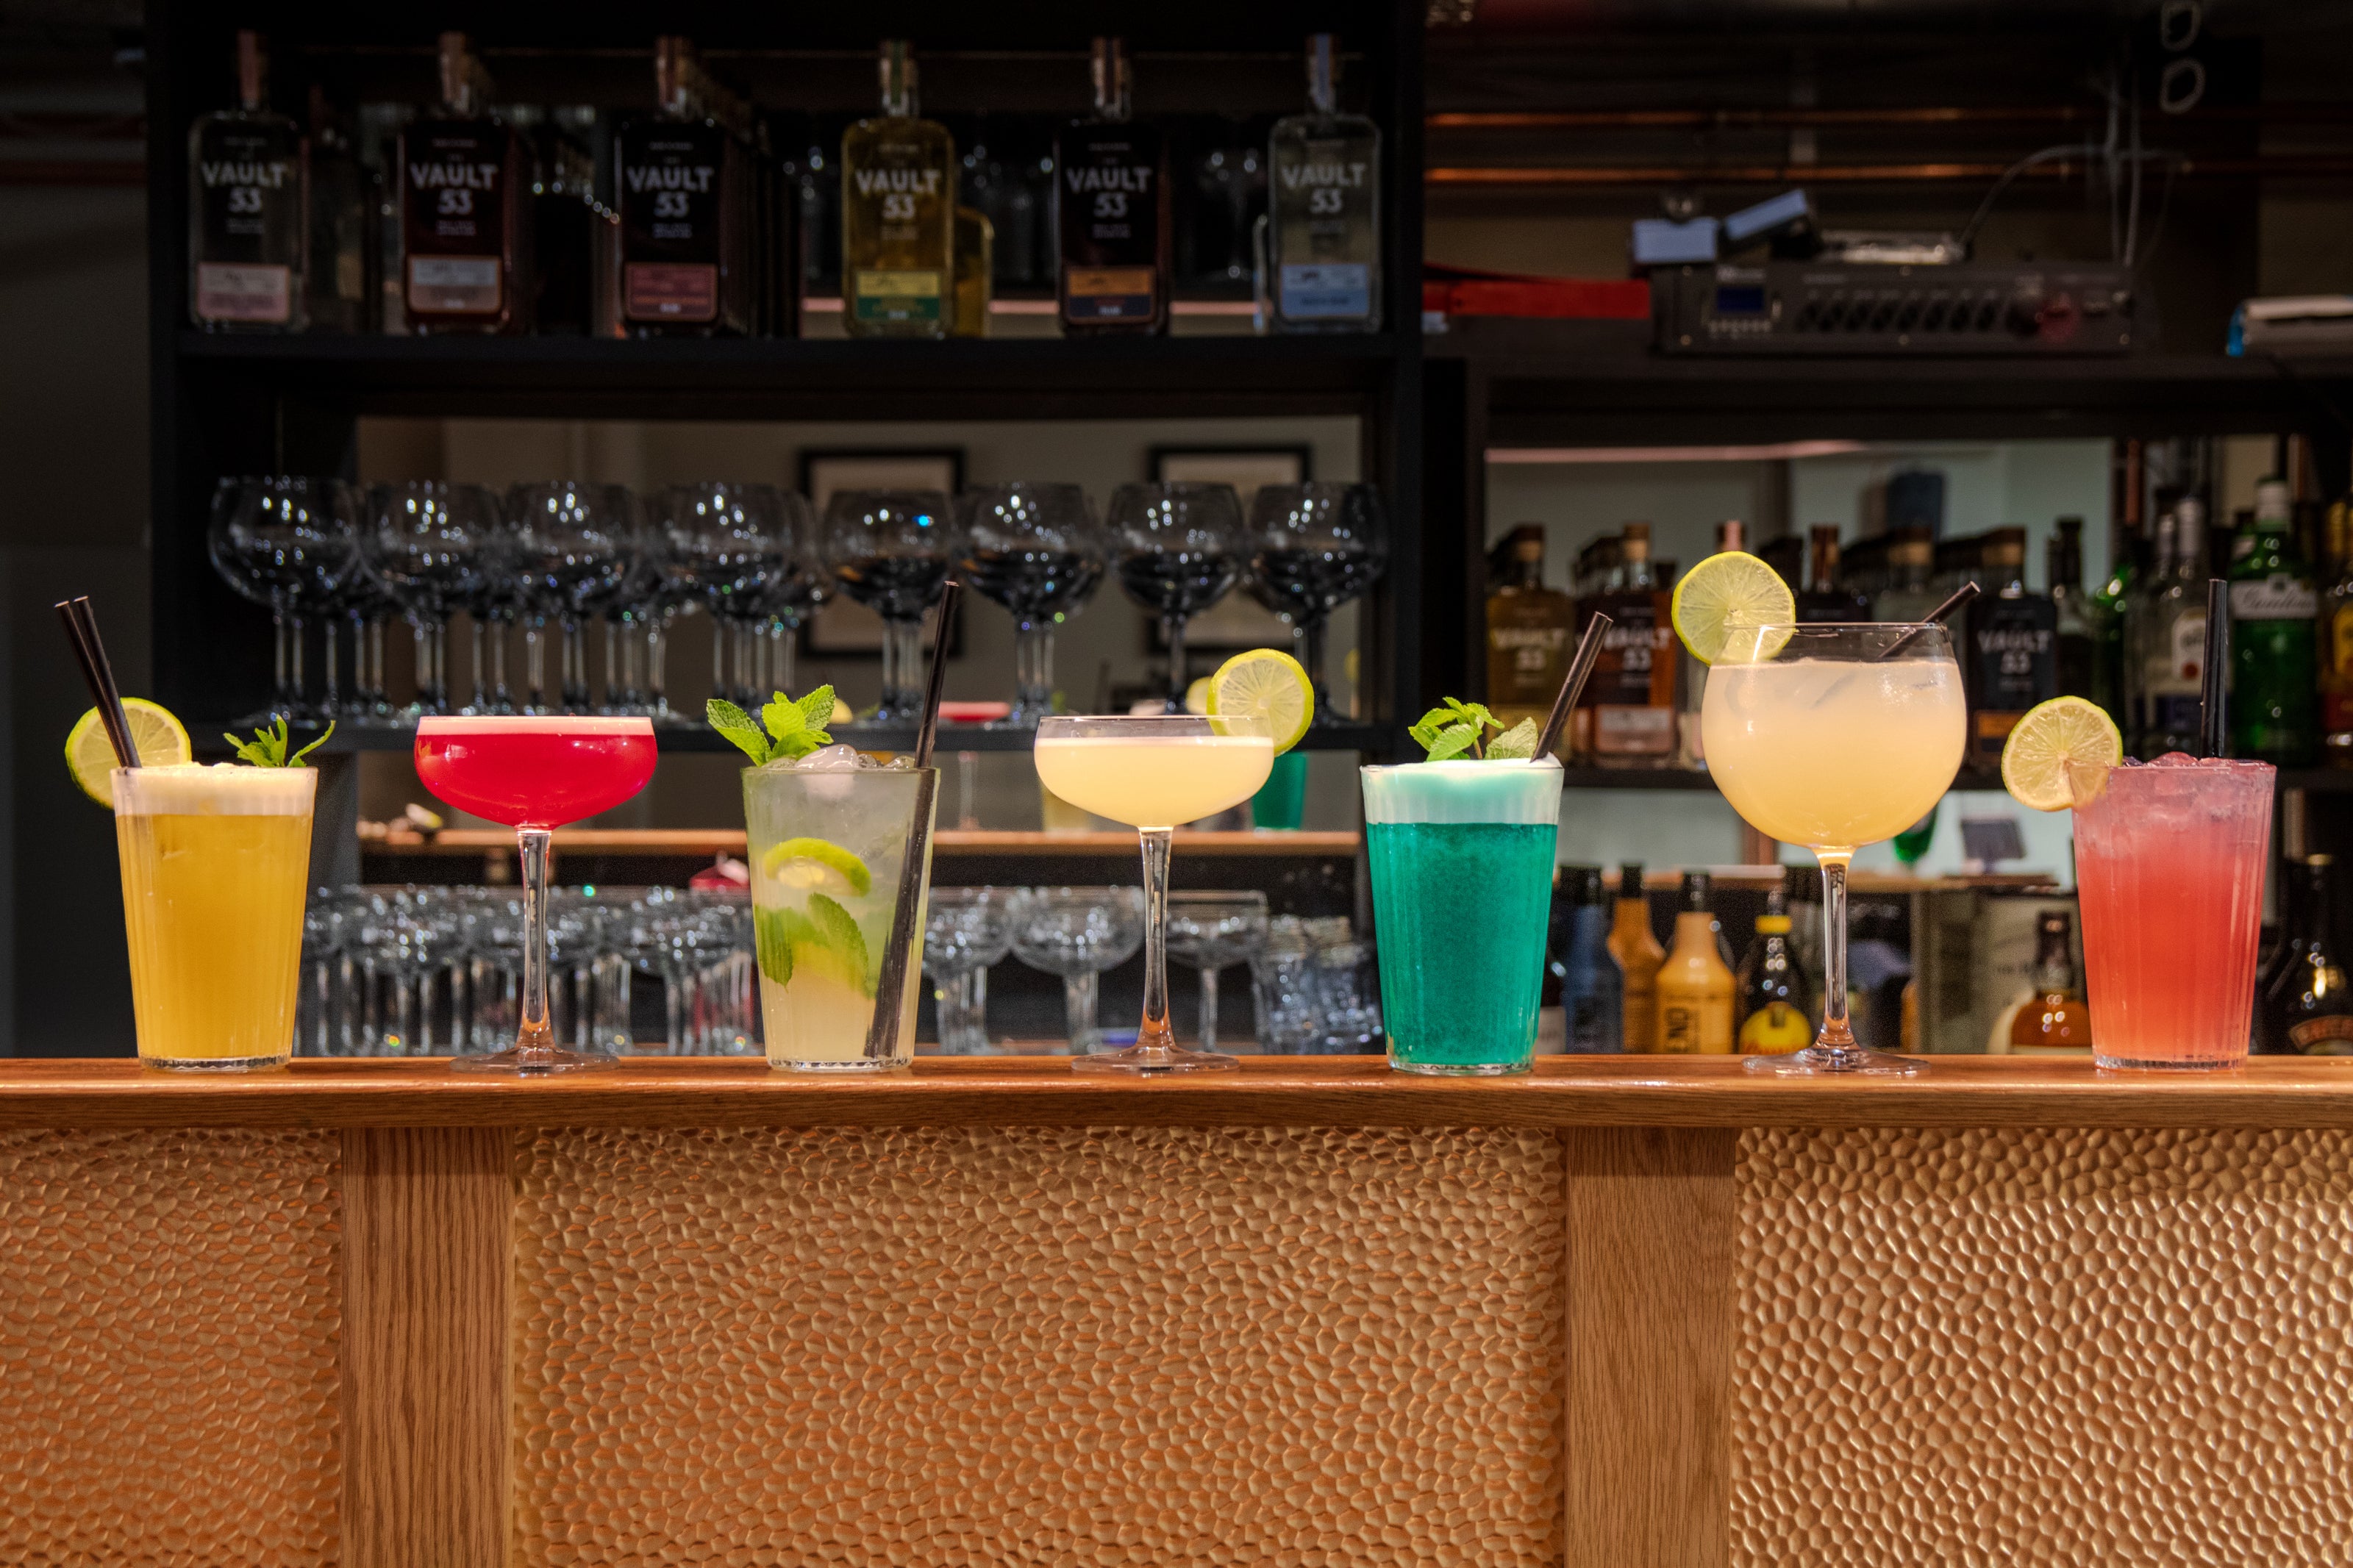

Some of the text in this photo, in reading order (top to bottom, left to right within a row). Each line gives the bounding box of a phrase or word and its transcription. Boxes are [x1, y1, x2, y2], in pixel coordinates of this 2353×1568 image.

[201, 162, 288, 188] VAULT
[410, 162, 498, 189] VAULT
[626, 167, 713, 193] VAULT
[854, 169, 941, 195] VAULT
[1066, 167, 1152, 193] VAULT
[1282, 162, 1366, 189] VAULT
[229, 188, 262, 213] 53
[438, 189, 472, 215] 53
[654, 192, 689, 217] 53
[883, 194, 915, 219] 53
[1094, 192, 1127, 217] 53
[1309, 188, 1342, 213] 53
